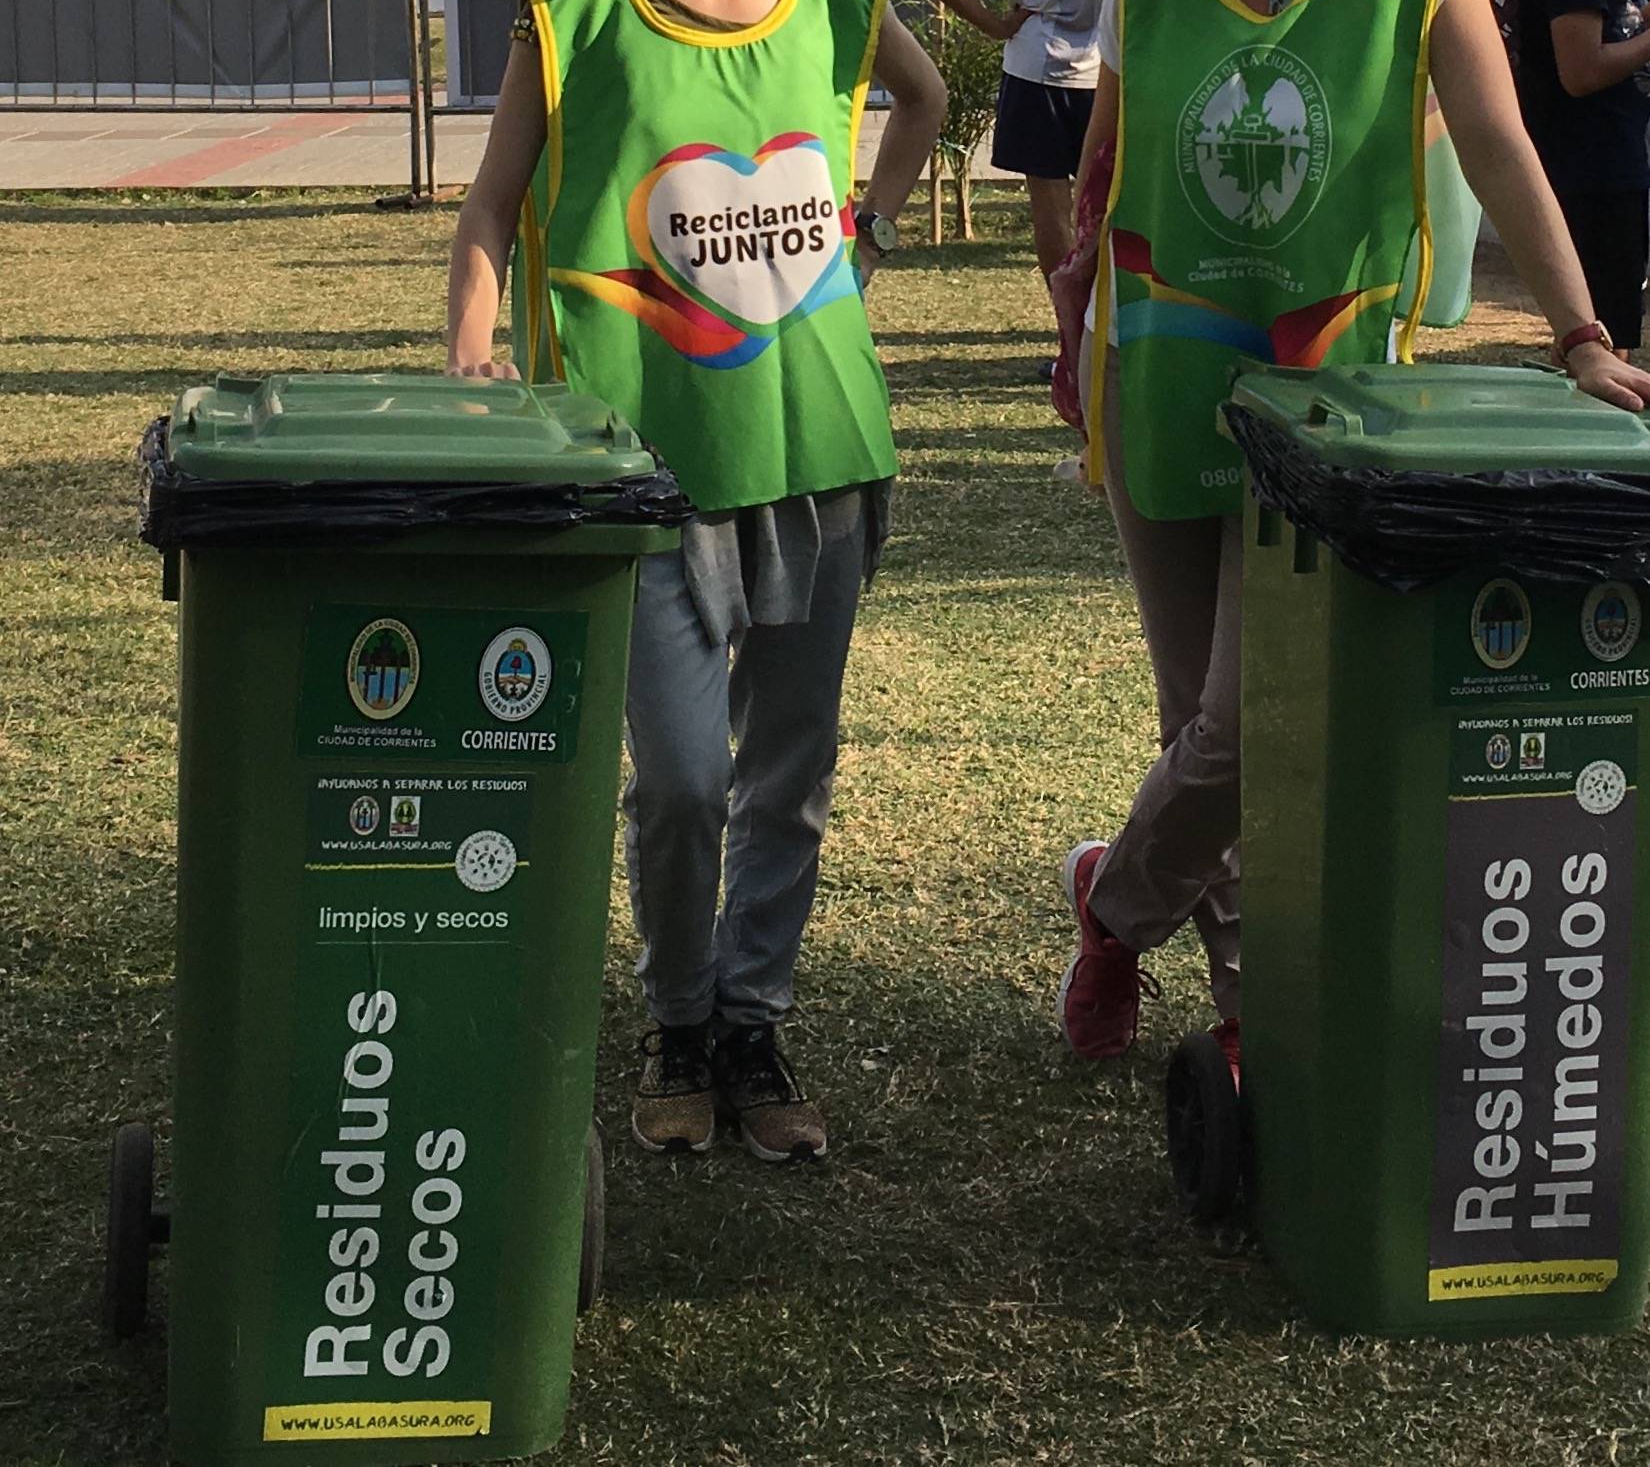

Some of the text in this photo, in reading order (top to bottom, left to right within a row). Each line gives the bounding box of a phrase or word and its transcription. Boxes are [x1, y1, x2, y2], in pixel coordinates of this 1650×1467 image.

[1182, 53, 1326, 182] MUNICIPALIDAD DE LA CIUDAD DE CORRIENTES
[669, 196, 834, 237] Reciclando
[690, 224, 825, 268] JUNTOS
[1570, 669, 1649, 689] CORRIENTES
[1523, 717, 1563, 728] SEPARAR
[1567, 716, 1585, 726] LOS
[317, 735, 436, 748] CIUDAD DE CORRIENTES
[461, 730, 556, 751] CORRIENTES
[382, 779, 391, 789] A
[394, 779, 443, 790] SEPARAR
[447, 780, 468, 790] LOS
[472, 780, 528, 791] RESIDUOS!
[319, 907, 508, 932] limpios y secos
[1454, 857, 1531, 1231] Residuos
[1531, 852, 1608, 1228] Húmedos
[303, 989, 397, 1377] Residuos
[383, 1127, 467, 1378] Secos
[1442, 1271, 1604, 1289] WWW.USALABASURA.ORG
[281, 1413, 475, 1431] WWW.USALABASURA.ORG
